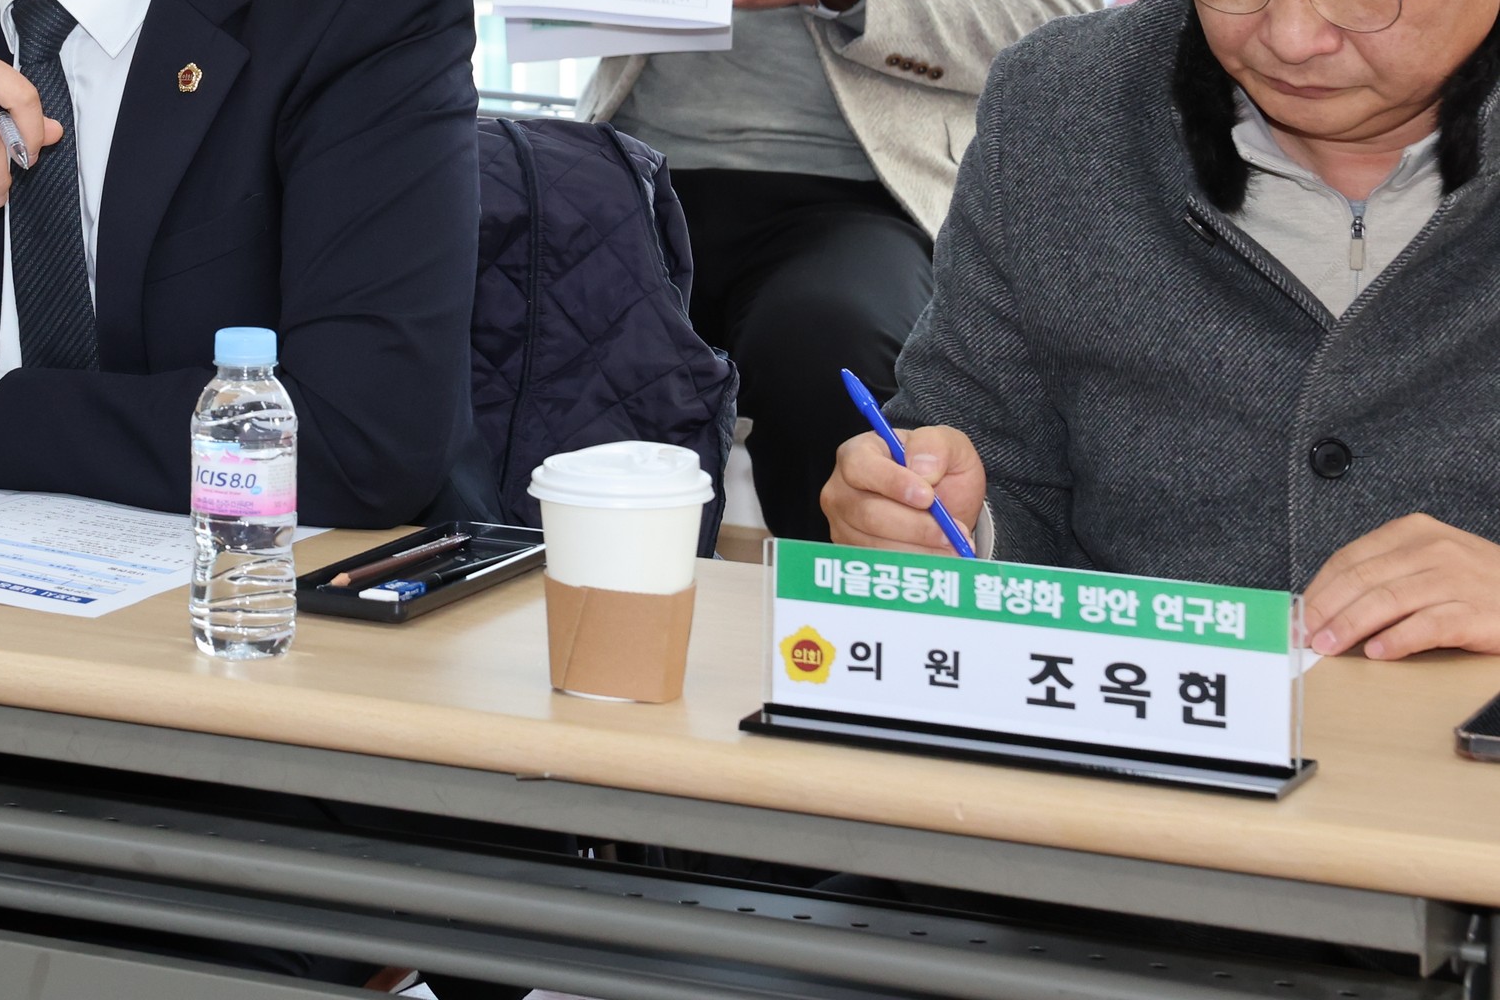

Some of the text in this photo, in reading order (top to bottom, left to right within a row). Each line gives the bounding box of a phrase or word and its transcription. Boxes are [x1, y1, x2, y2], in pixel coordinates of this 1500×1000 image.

[813, 557, 1246, 640] 마을공동체 활성화 방안 연구회
[793, 647, 822, 665] 의회
[1025, 653, 1227, 729] 조옥현
